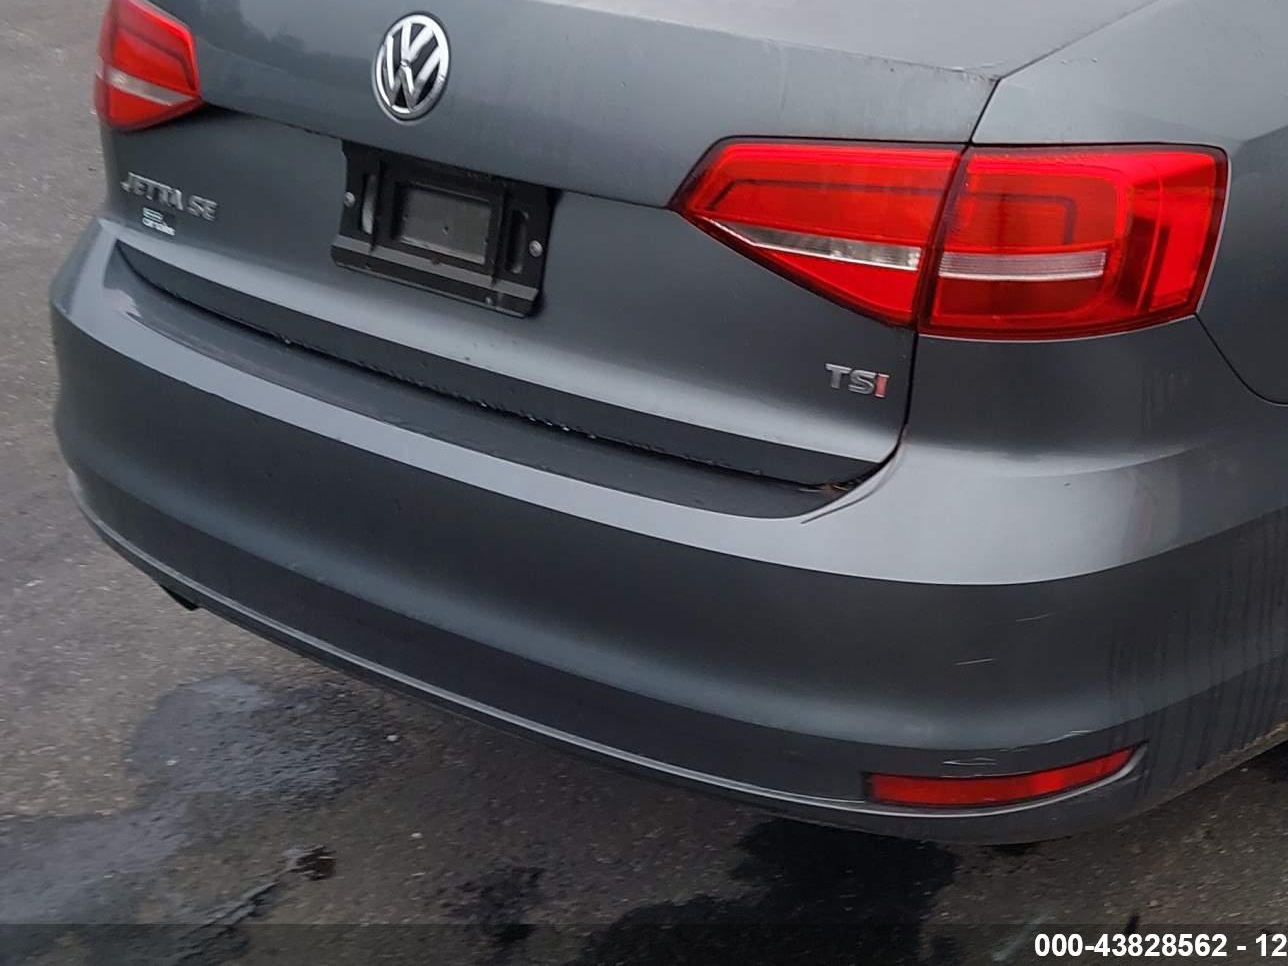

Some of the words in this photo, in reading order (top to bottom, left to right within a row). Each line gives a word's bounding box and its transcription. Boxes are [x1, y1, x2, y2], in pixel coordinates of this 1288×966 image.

[120, 171, 183, 210] JETTA
[187, 194, 218, 222] SE
[825, 363, 890, 398] TSI
